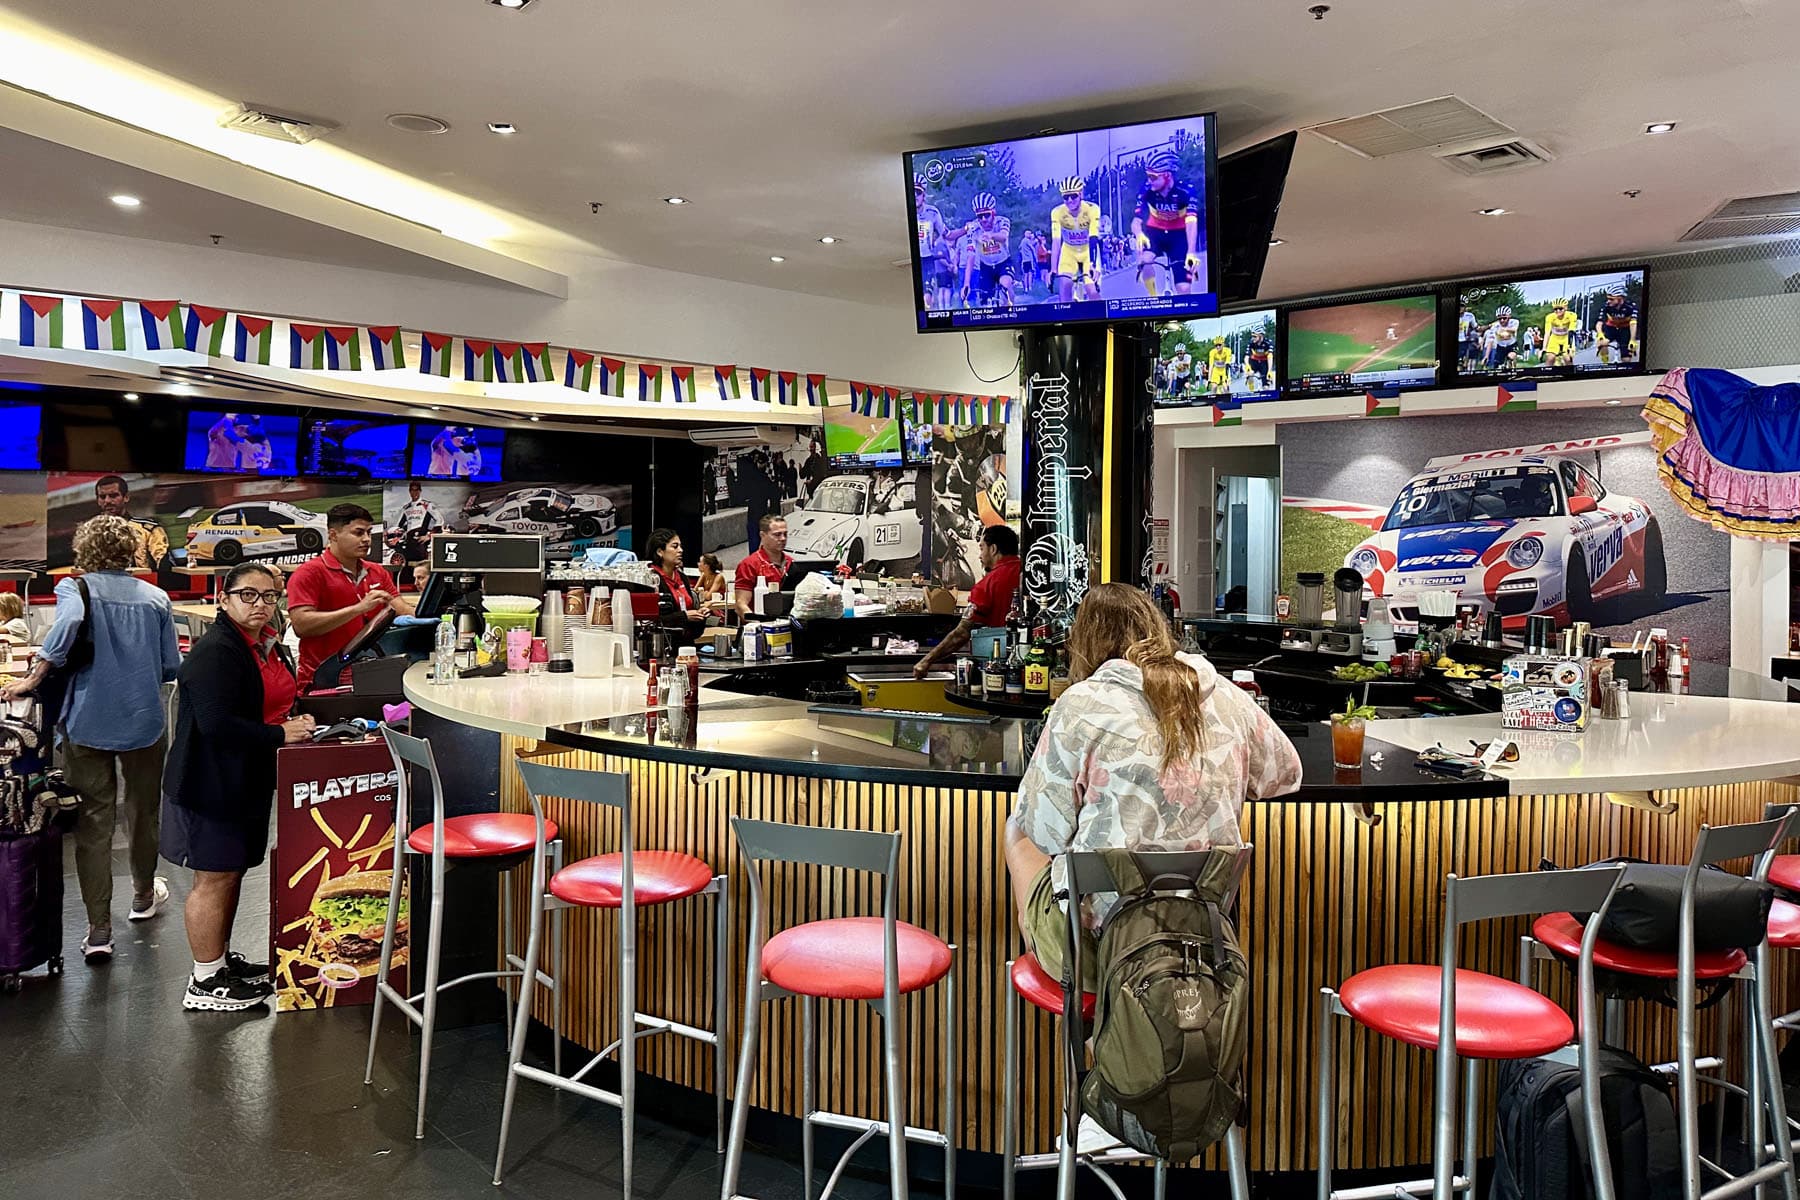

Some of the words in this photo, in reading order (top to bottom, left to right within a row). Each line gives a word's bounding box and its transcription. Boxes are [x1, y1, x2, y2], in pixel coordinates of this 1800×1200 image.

[1155, 203, 1178, 212] UAE
[1460, 437, 1622, 463] POLAND
[819, 480, 865, 491] PLAYERS
[1413, 479, 1477, 495] Giermaziak
[1394, 495, 1427, 516] 10
[511, 521, 550, 532] TOYOTA
[876, 527, 888, 543] 21
[1399, 553, 1478, 568] verva
[1589, 525, 1624, 584] verva
[1414, 576, 1464, 585] MICHELIN
[293, 770, 398, 809] PLAYERS
[374, 794, 392, 802] COS
